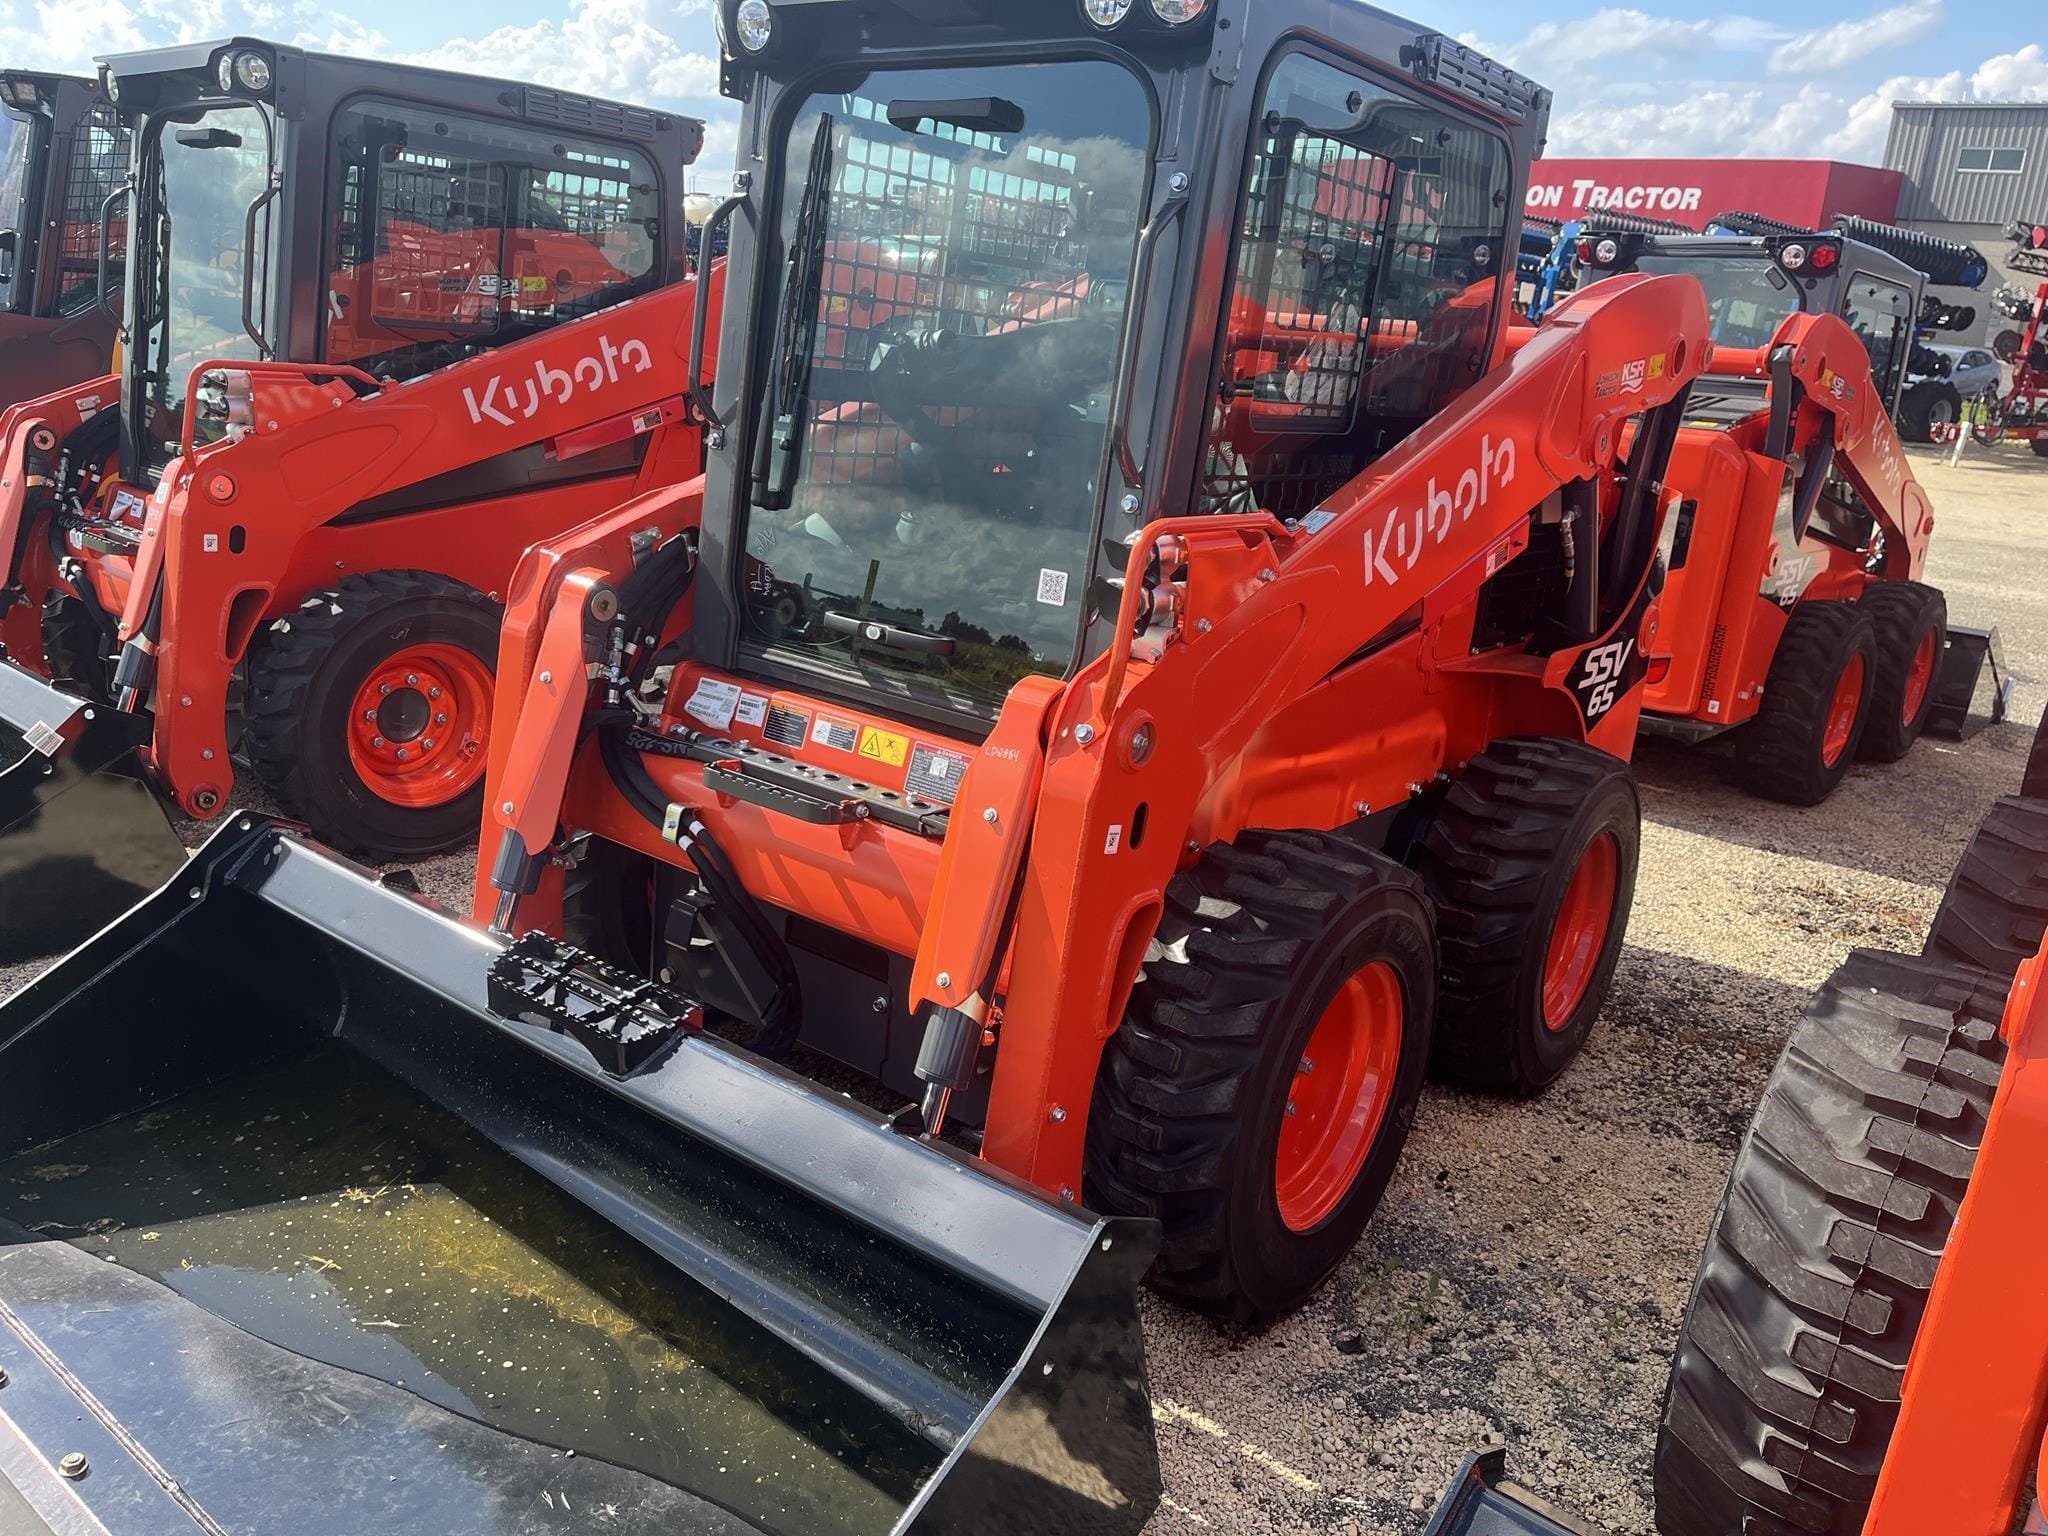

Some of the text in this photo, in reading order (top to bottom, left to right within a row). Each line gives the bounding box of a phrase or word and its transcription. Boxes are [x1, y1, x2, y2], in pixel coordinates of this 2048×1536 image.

[1572, 179, 1702, 210] TRACTOR
[462, 335, 652, 427] Kubota
[1621, 359, 1645, 382] KSR
[1363, 433, 1515, 587] Kubota
[1775, 556, 1811, 587] SSV
[1779, 583, 1800, 607] 65
[1578, 638, 1635, 690] SSV
[1587, 680, 1618, 717] 65
